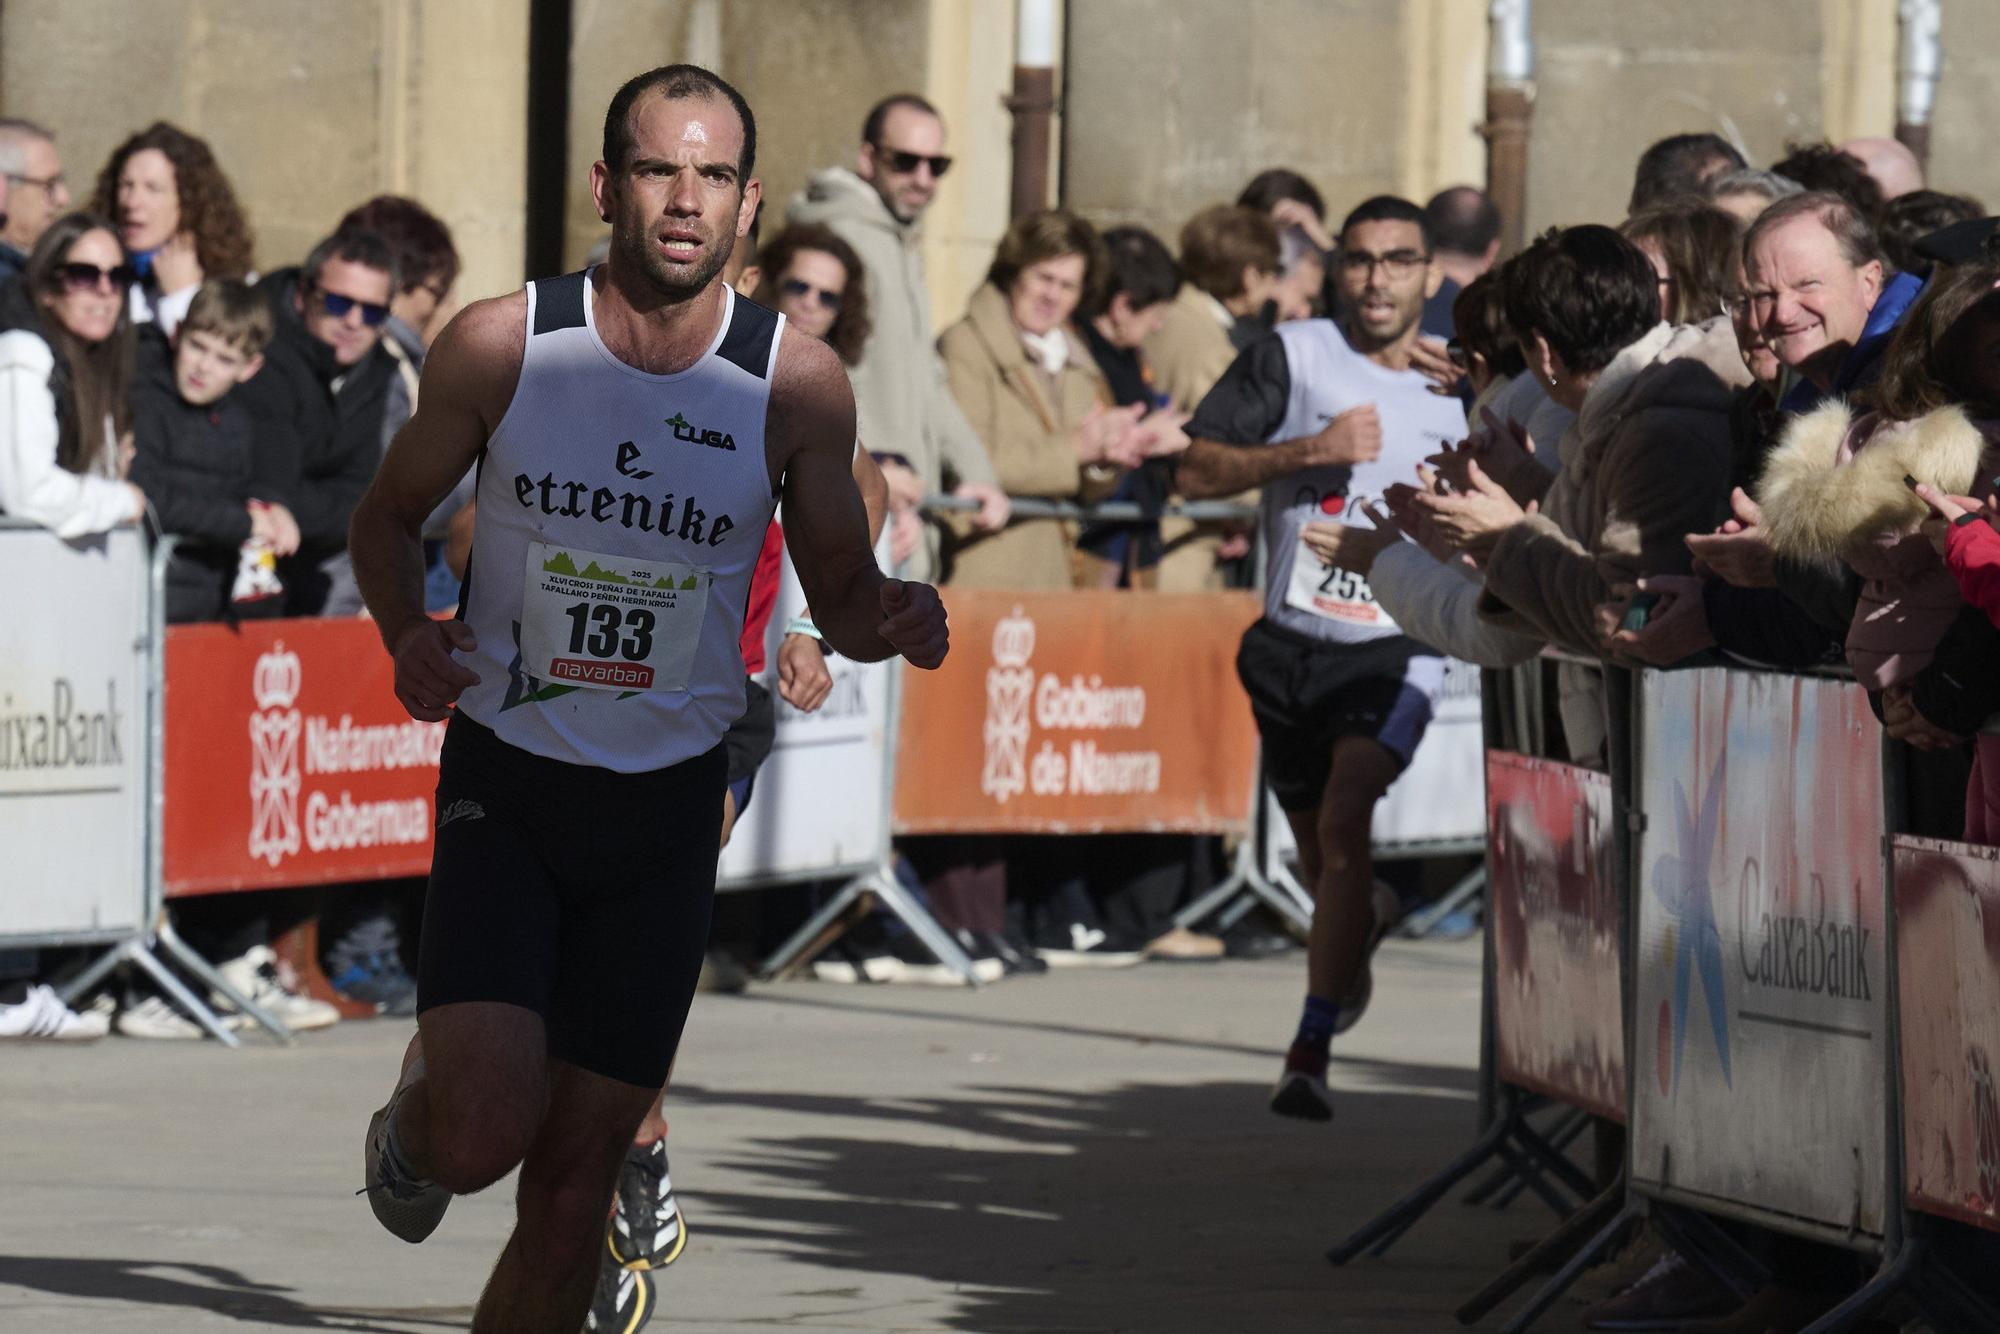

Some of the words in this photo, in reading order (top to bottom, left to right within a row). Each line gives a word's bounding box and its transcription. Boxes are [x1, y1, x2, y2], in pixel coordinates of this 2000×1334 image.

[514, 471, 734, 547] etxenike
[541, 583, 589, 598] TAFALLAKO
[591, 592, 620, 603] PEÑEN
[621, 596, 647, 606] HERRI
[648, 600, 676, 609] KROSA
[549, 575, 568, 586] XLVI
[568, 579, 594, 590] CROSS
[596, 583, 624, 594] PEÑAS
[626, 586, 638, 596] DE
[641, 590, 677, 600] TAFALLA
[631, 570, 652, 579] 2025
[565, 602, 656, 661] 133
[556, 662, 649, 683] navarban
[1036, 673, 1146, 729] Gobierno
[0, 677, 124, 770] ixaBank
[305, 714, 447, 775] Nafarroako
[1030, 740, 1067, 796] de
[1069, 740, 1161, 796] Navarra
[305, 790, 429, 852] Gobernua
[1738, 856, 1872, 1001] CaixaBank
